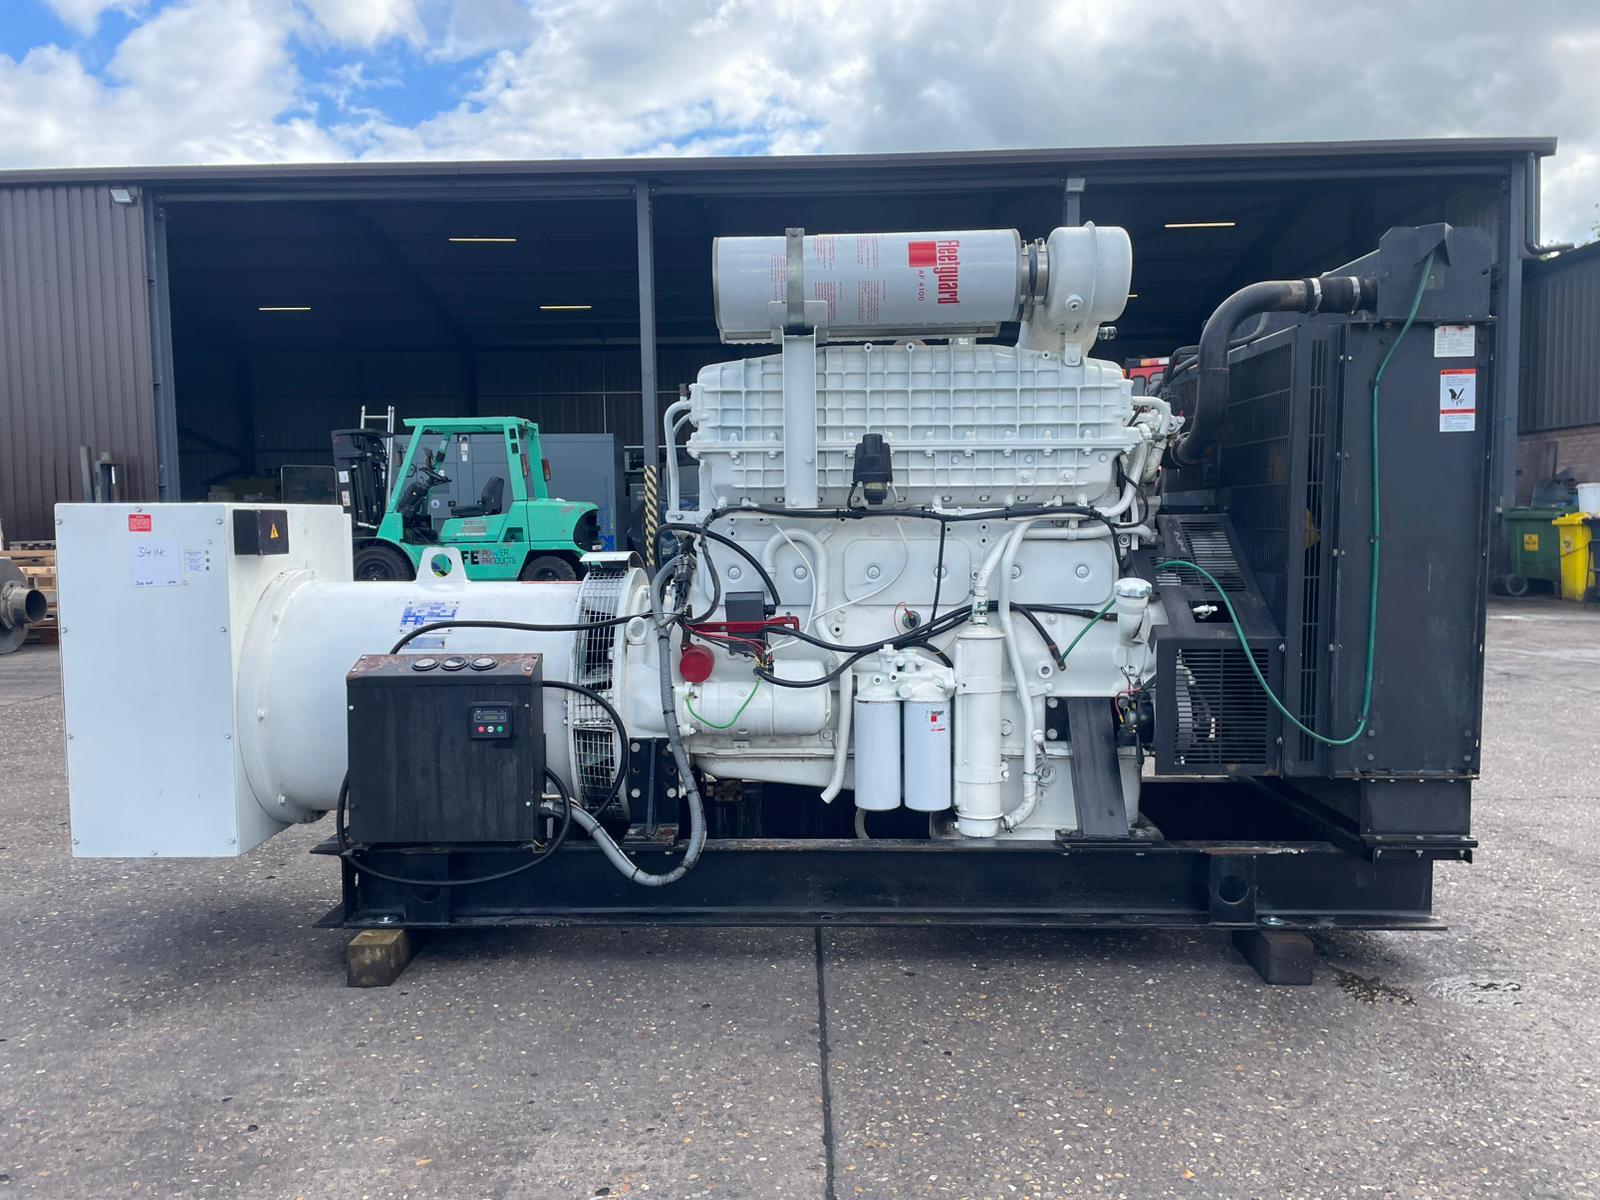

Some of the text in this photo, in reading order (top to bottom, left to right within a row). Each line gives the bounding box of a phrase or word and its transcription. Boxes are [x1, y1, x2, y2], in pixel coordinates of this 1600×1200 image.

[918, 269, 925, 280] AF
[932, 240, 960, 304] Fleetguard
[137, 546, 166, 558] 3414
[481, 556, 517, 565] PRODUCTS
